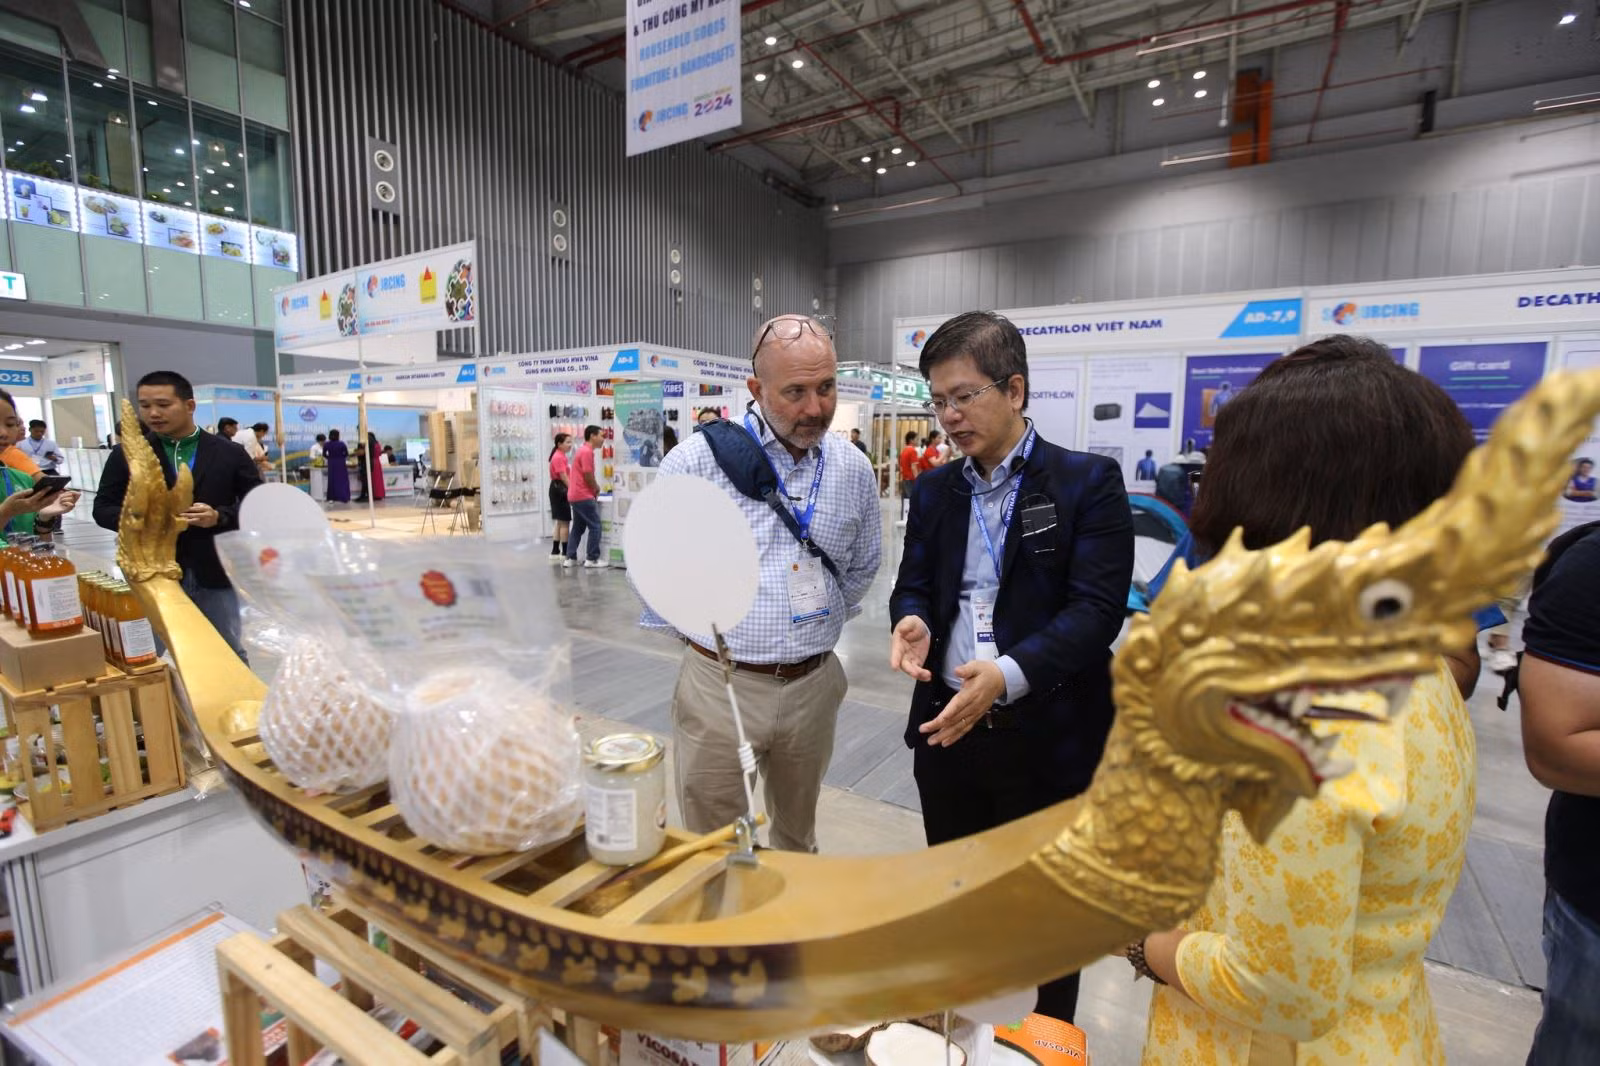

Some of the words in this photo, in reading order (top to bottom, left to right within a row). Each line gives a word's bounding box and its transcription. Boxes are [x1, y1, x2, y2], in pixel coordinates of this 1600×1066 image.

[693, 93, 733, 117] 2024
[1016, 323, 1091, 336] DECATHLON
[1129, 318, 1163, 330] NAM
[663, 383, 683, 393] VIBES
[637, 1032, 702, 1066] VICOSA
